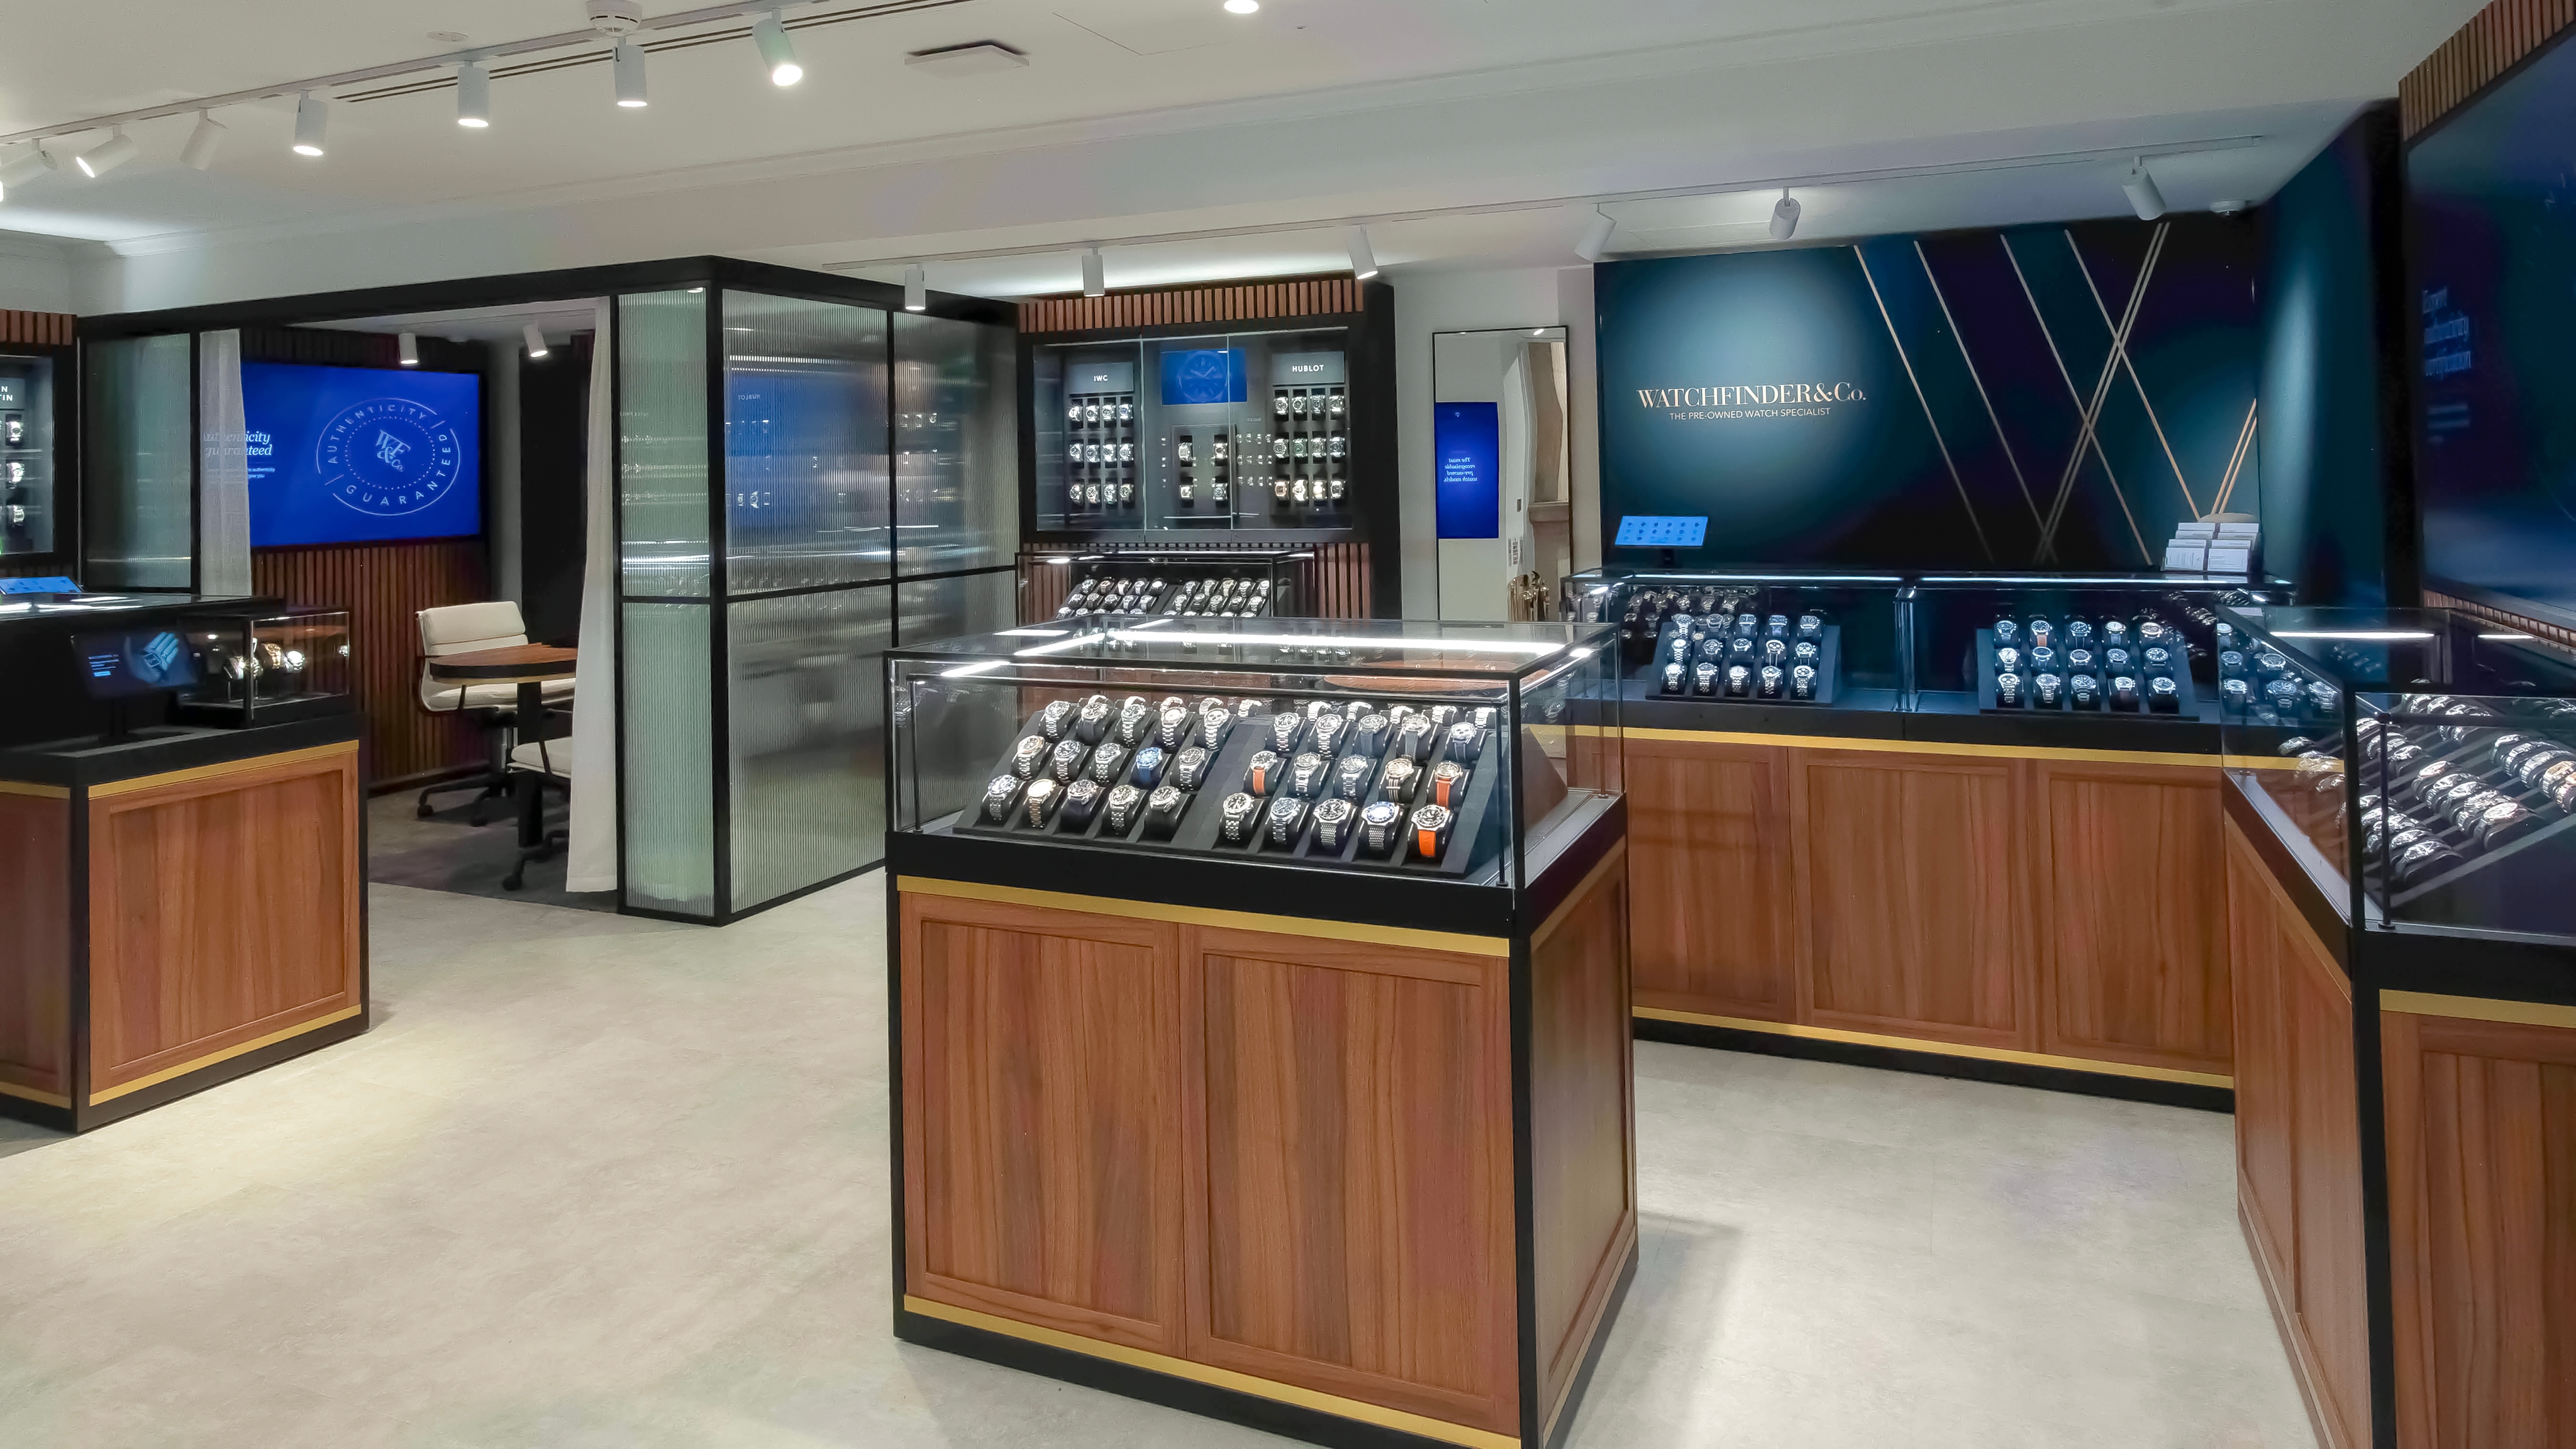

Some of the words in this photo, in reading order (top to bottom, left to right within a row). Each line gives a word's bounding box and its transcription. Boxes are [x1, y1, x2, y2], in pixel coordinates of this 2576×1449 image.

[1292, 364, 1324, 372] HUBLOT
[1636, 382, 1866, 409] WATCHFINDER&Co.
[1689, 410, 1743, 419] PRE-OWNED
[1745, 409, 1778, 418] WATCH
[1780, 408, 1831, 417] SPECIALIST
[203, 430, 270, 445] utenicity
[327, 404, 427, 464] AUTHENTICITY
[205, 444, 272, 458] gurateed
[347, 434, 451, 506] GUARANTEED
